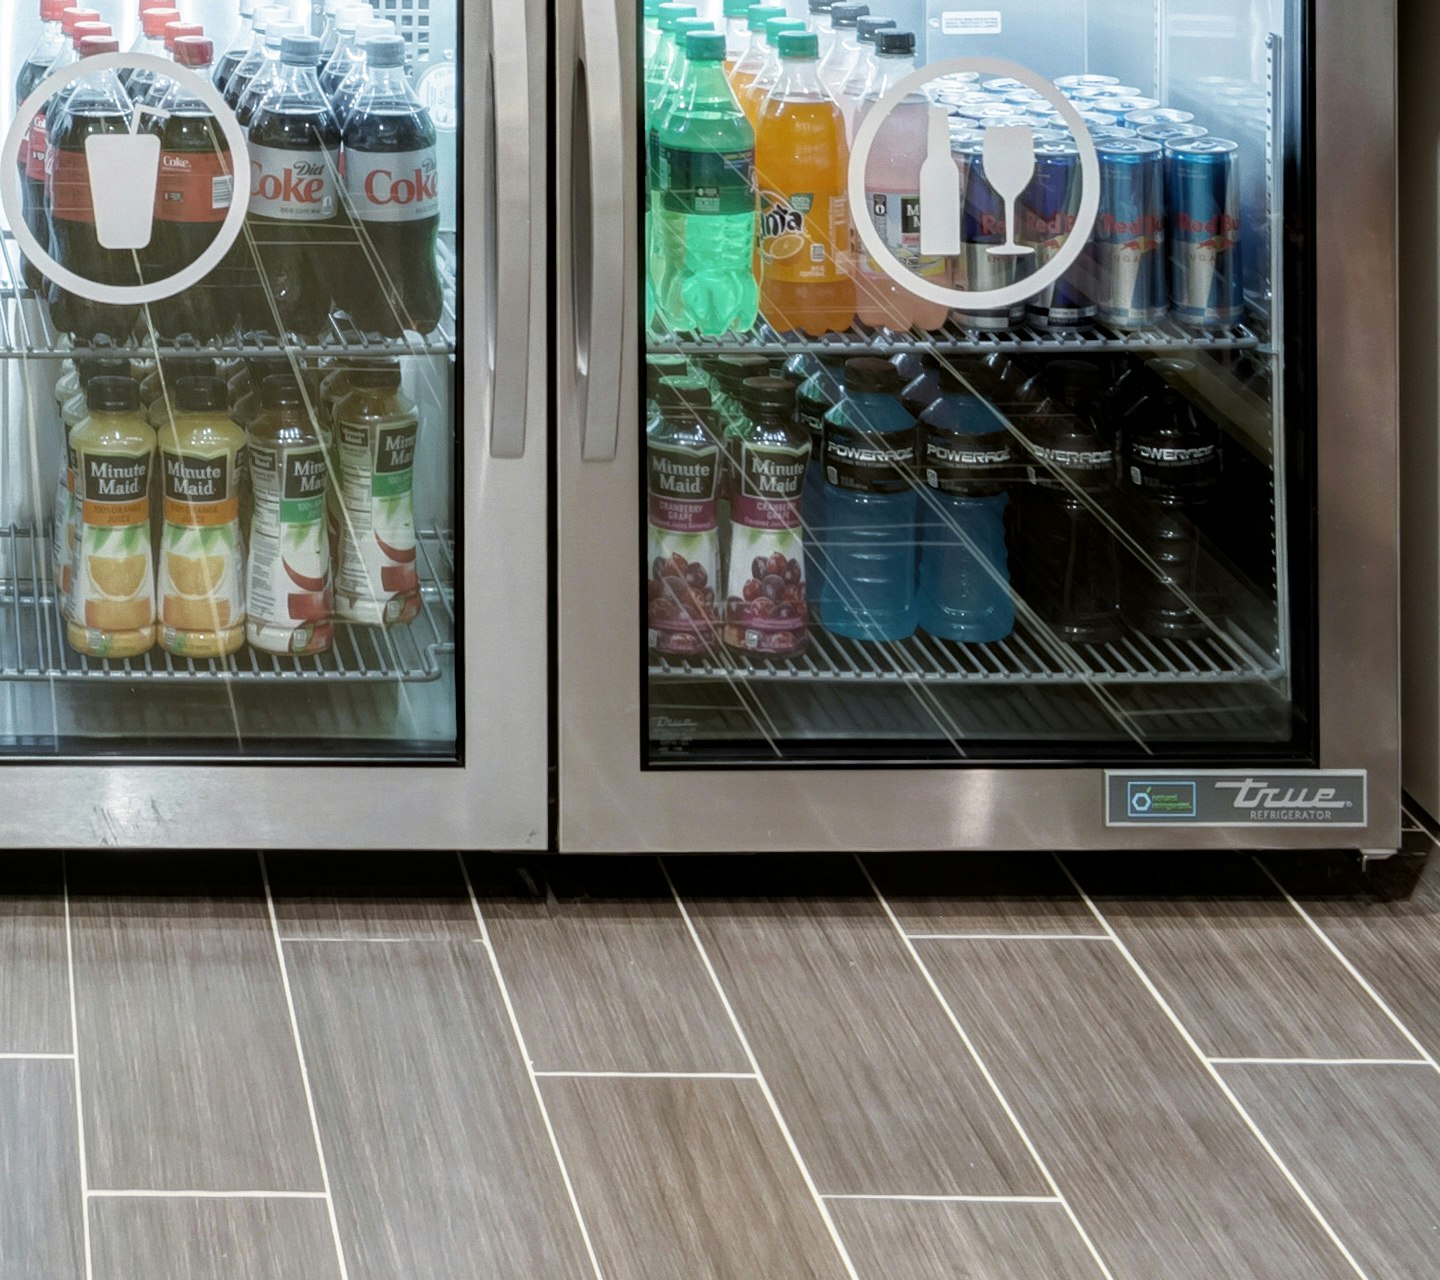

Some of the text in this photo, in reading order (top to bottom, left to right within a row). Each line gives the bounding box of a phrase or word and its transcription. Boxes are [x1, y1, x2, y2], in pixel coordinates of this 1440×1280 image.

[162, 155, 190, 169] Coke
[293, 160, 324, 176] Diet
[827, 442, 916, 463] POWERADE
[927, 443, 1011, 464] POWERADE
[90, 461, 146, 479] Minute
[167, 460, 221, 478] Minute
[653, 456, 710, 476] Minute
[752, 457, 804, 476] Minute
[98, 478, 140, 495] Maid
[173, 478, 216, 496] Maid
[660, 476, 702, 493] Maid
[759, 475, 797, 492] Maid
[658, 501, 703, 513] CRANBERRY
[1250, 809, 1333, 821] REFRIGERATOR
